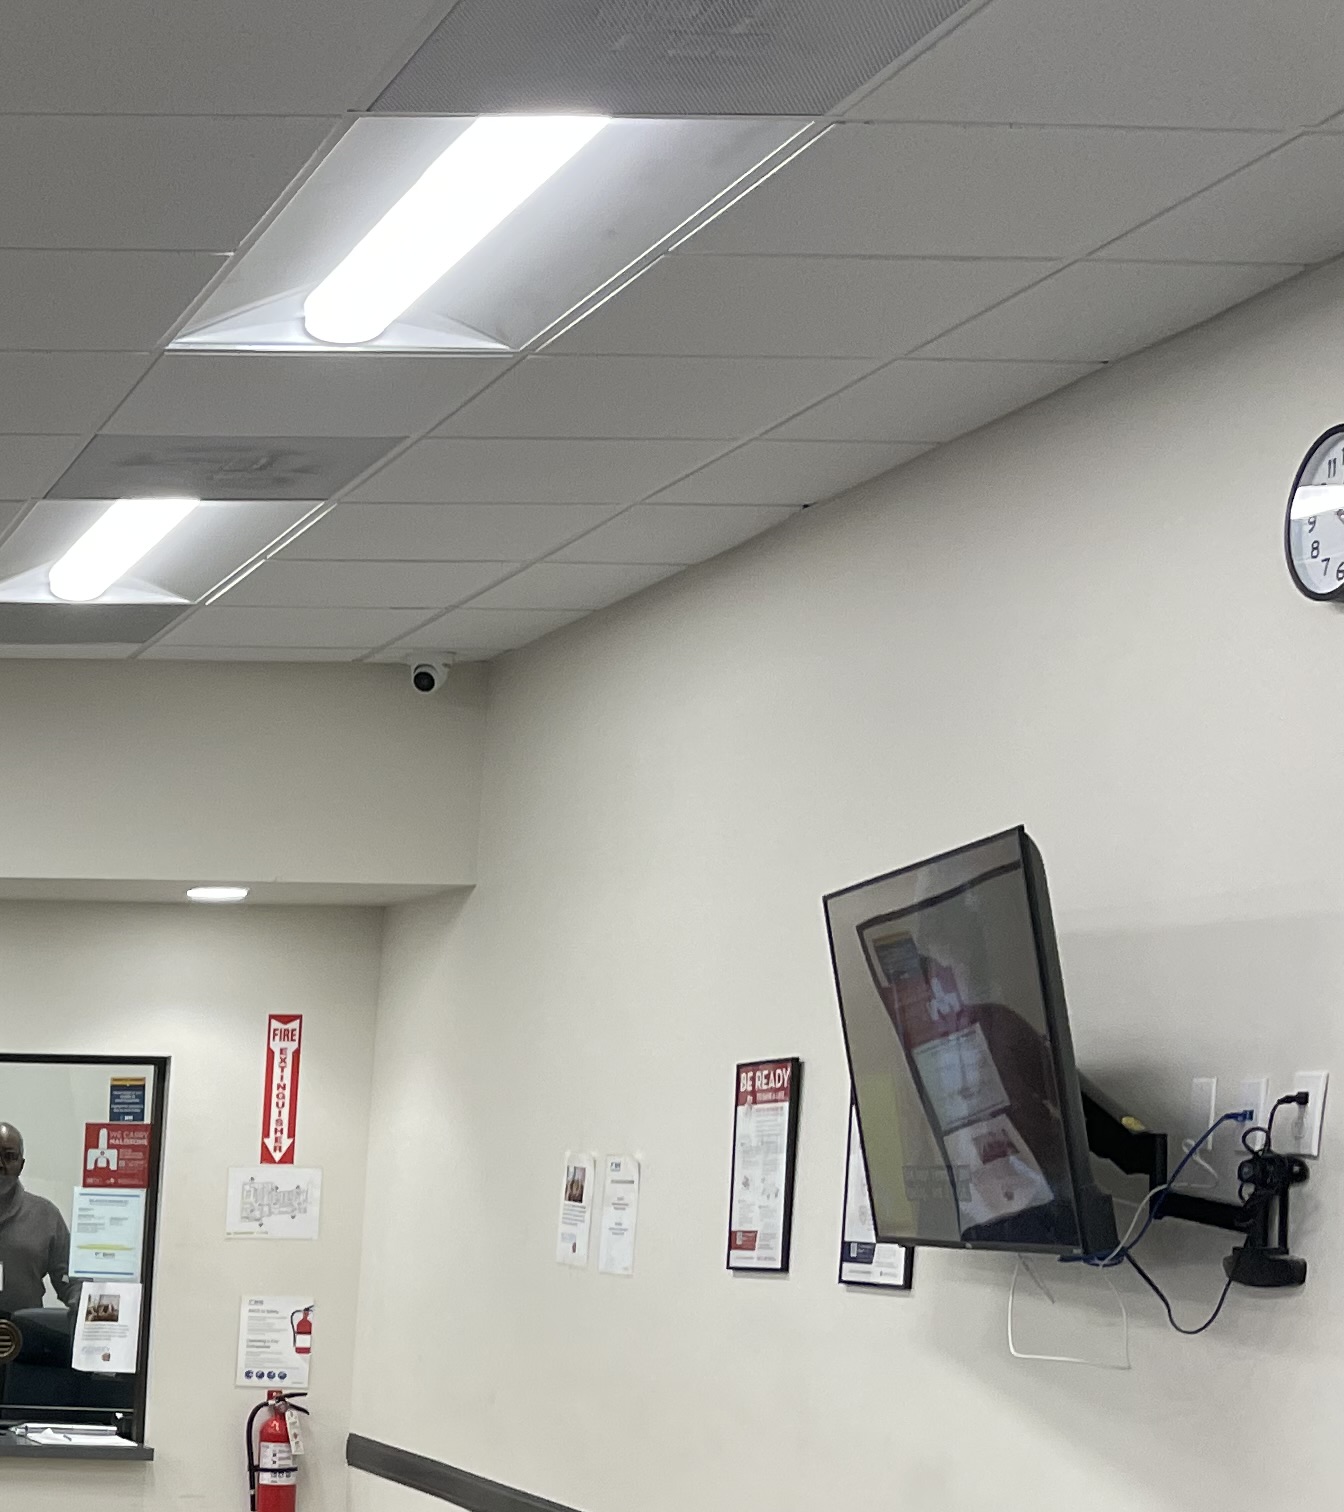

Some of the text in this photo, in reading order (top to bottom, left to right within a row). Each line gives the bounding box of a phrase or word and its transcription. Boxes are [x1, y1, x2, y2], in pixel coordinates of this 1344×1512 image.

[1328, 458, 1337, 478] 11
[1308, 516, 1317, 533] 9
[1312, 540, 1320, 558] 8
[1321, 558, 1330, 576] 7
[272, 1028, 297, 1042] FIRE
[740, 1067, 790, 1092] BE READY
[273, 1048, 288, 1153] EXTINGUISHER
